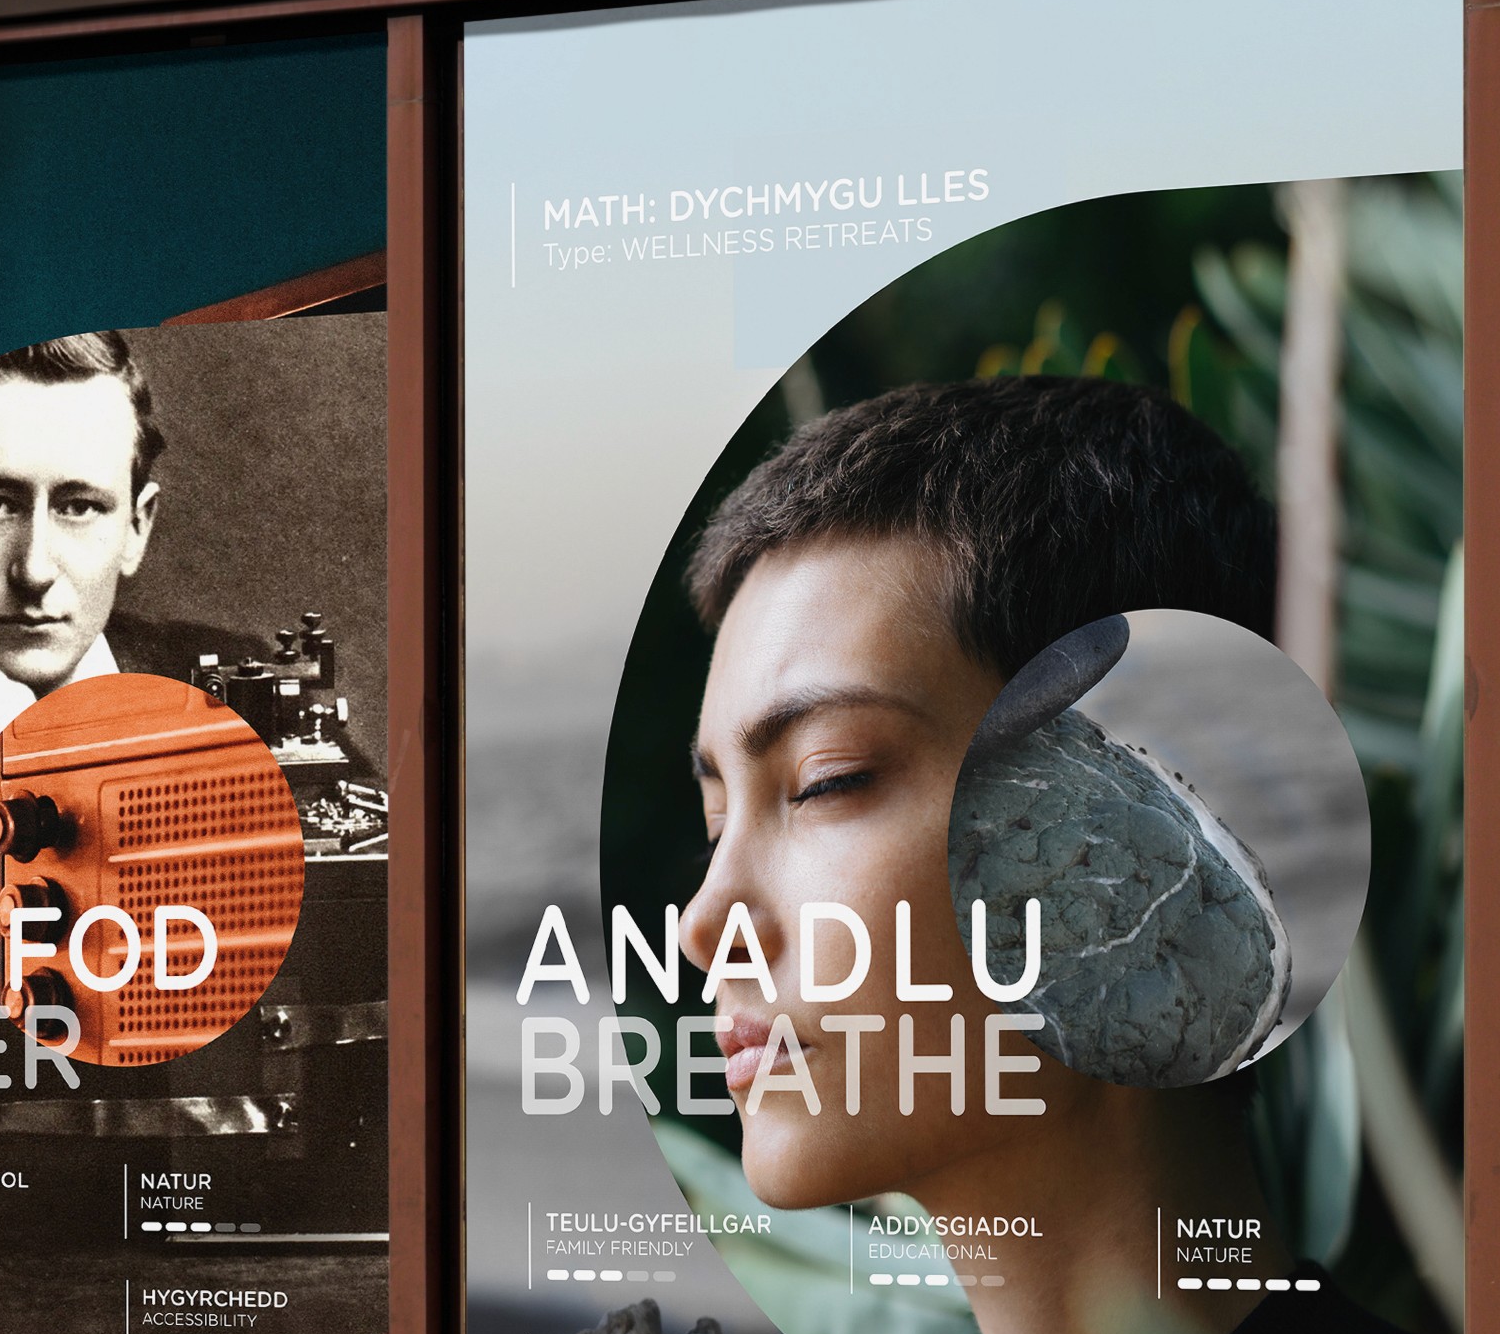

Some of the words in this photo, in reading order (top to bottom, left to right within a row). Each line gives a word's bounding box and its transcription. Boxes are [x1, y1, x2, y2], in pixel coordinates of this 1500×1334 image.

[544, 194, 656, 230] MATH:
[670, 176, 882, 222] DYCHMYGU
[899, 169, 989, 206] LLES
[543, 243, 612, 271] Type:
[622, 229, 774, 262] WELLNESS
[785, 218, 932, 250] RETREATS
[516, 898, 1042, 1006] ANADLU
[521, 1013, 1046, 1117] BREATHE
[141, 1171, 211, 1190] NATUR
[141, 1195, 204, 1210] NATURE
[546, 1212, 771, 1235] TEULU-GYFEILLGAR
[868, 1214, 1042, 1238] ADDYSGIADOL
[1176, 1217, 1261, 1239] NATUR
[546, 1238, 605, 1256] FAMILY
[611, 1239, 693, 1258] FRIENDLY
[869, 1242, 997, 1261] EDUCATIONAL
[1176, 1245, 1252, 1263] NATURE
[142, 1288, 288, 1309] HYGYRCHEDD
[142, 1311, 258, 1328] ACCESSIBILITY
